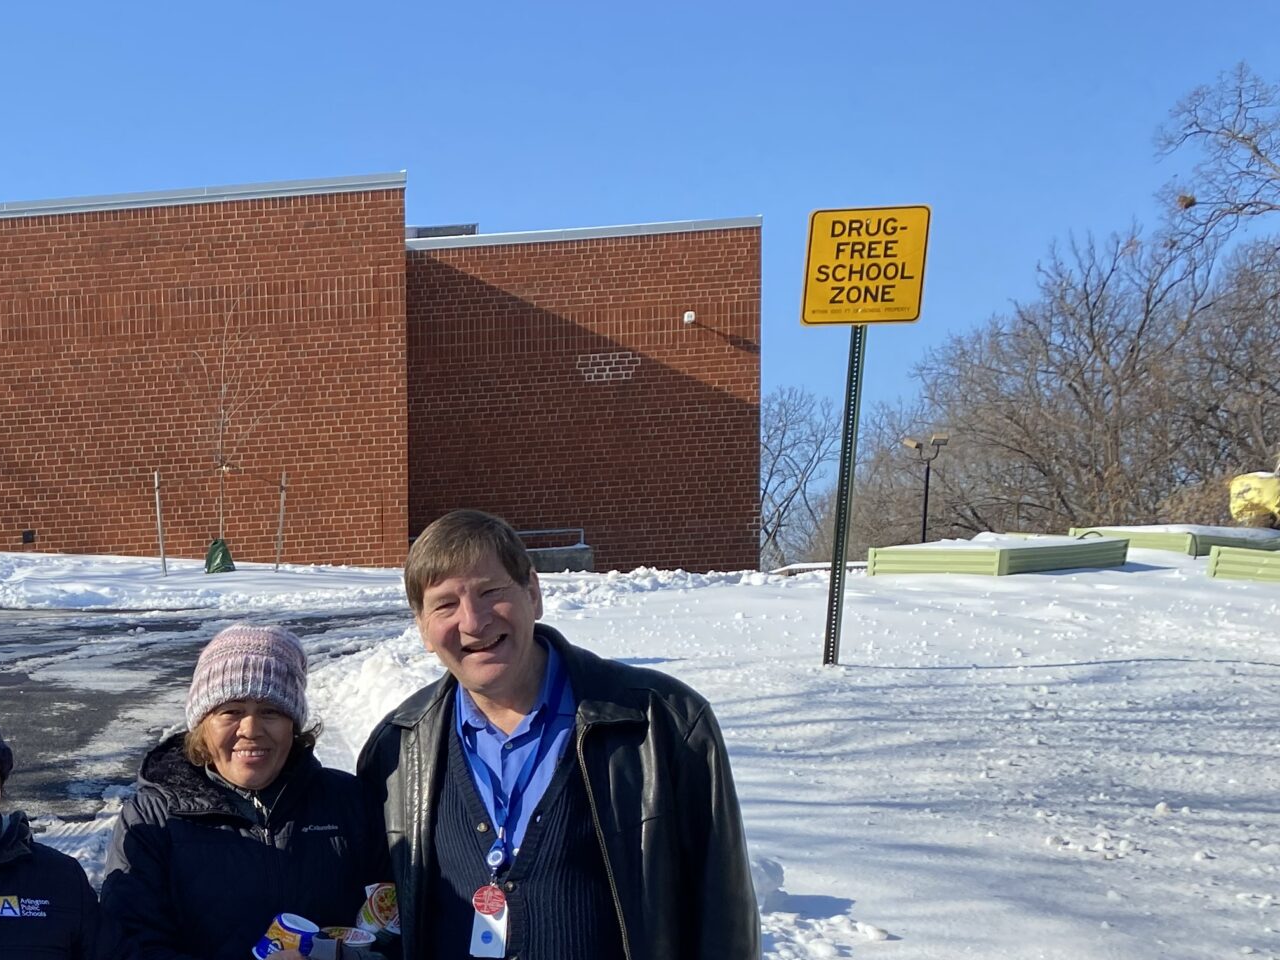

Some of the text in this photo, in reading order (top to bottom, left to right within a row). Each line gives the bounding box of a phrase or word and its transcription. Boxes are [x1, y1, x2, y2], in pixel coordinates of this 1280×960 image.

[830, 217, 908, 238] DRUG-
[835, 240, 899, 260] FREE
[815, 262, 915, 282] SCHOOL
[829, 284, 896, 304] ZONE
[20, 898, 50, 906] Arlington
